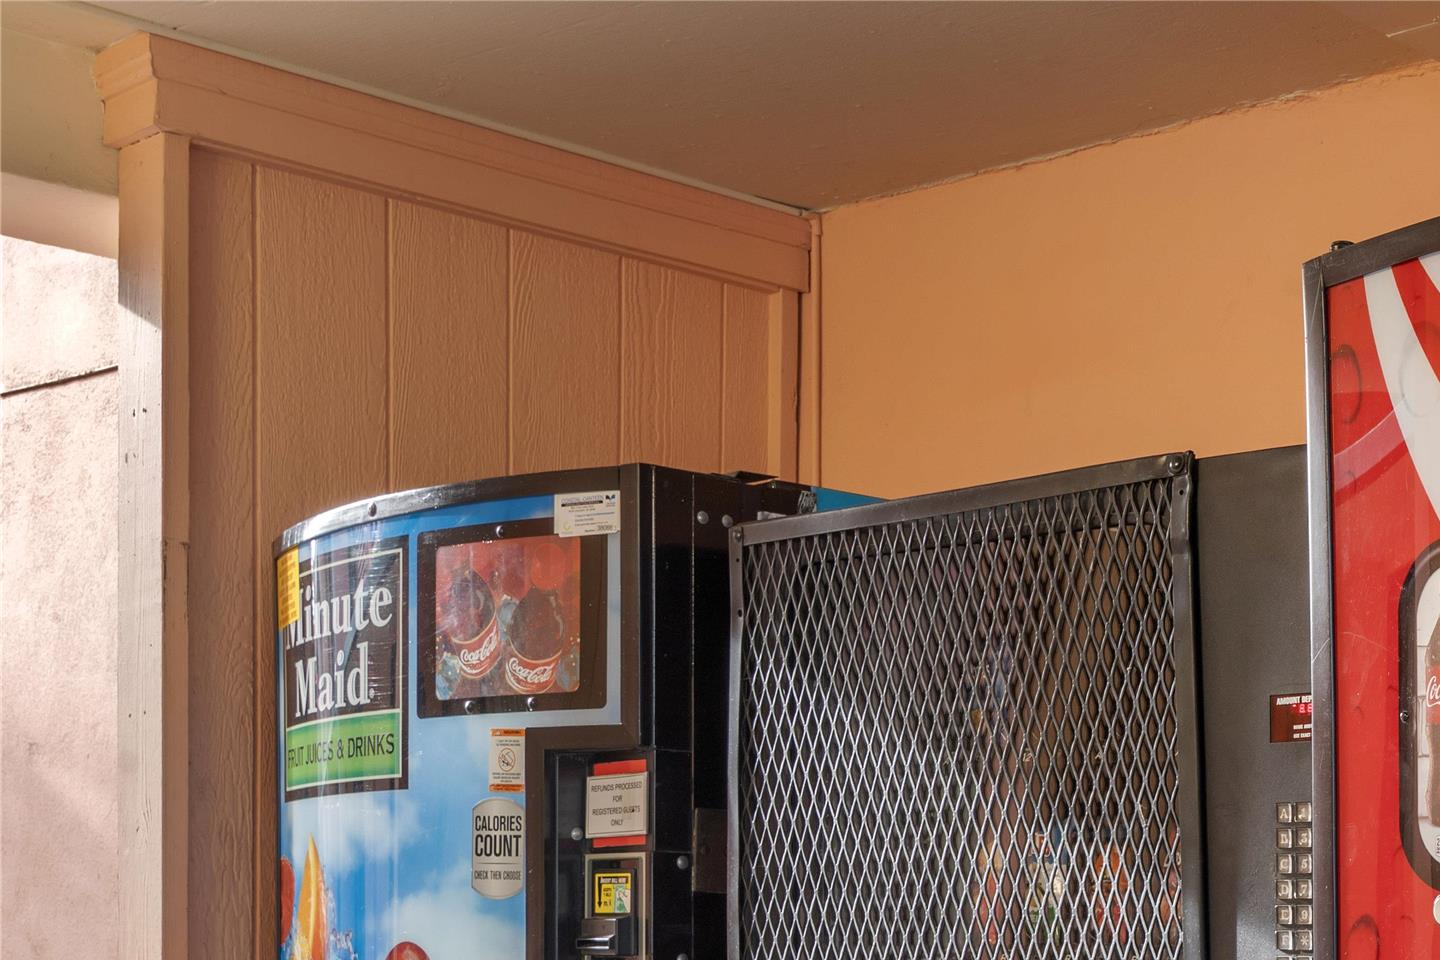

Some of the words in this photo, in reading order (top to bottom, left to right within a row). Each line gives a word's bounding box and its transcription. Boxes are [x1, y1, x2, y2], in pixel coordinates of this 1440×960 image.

[288, 745, 304, 769] FRUIT
[306, 740, 334, 767] JUICES
[347, 733, 395, 759] DRINKS
[591, 784, 614, 792] REFUNDS
[615, 781, 642, 790] PROCESSED
[592, 807, 622, 815] REGISTERED
[475, 815, 522, 832] CALORIES
[475, 834, 522, 857] COUNT
[474, 870, 489, 880] CHECK
[502, 870, 521, 880] CHOOSE
